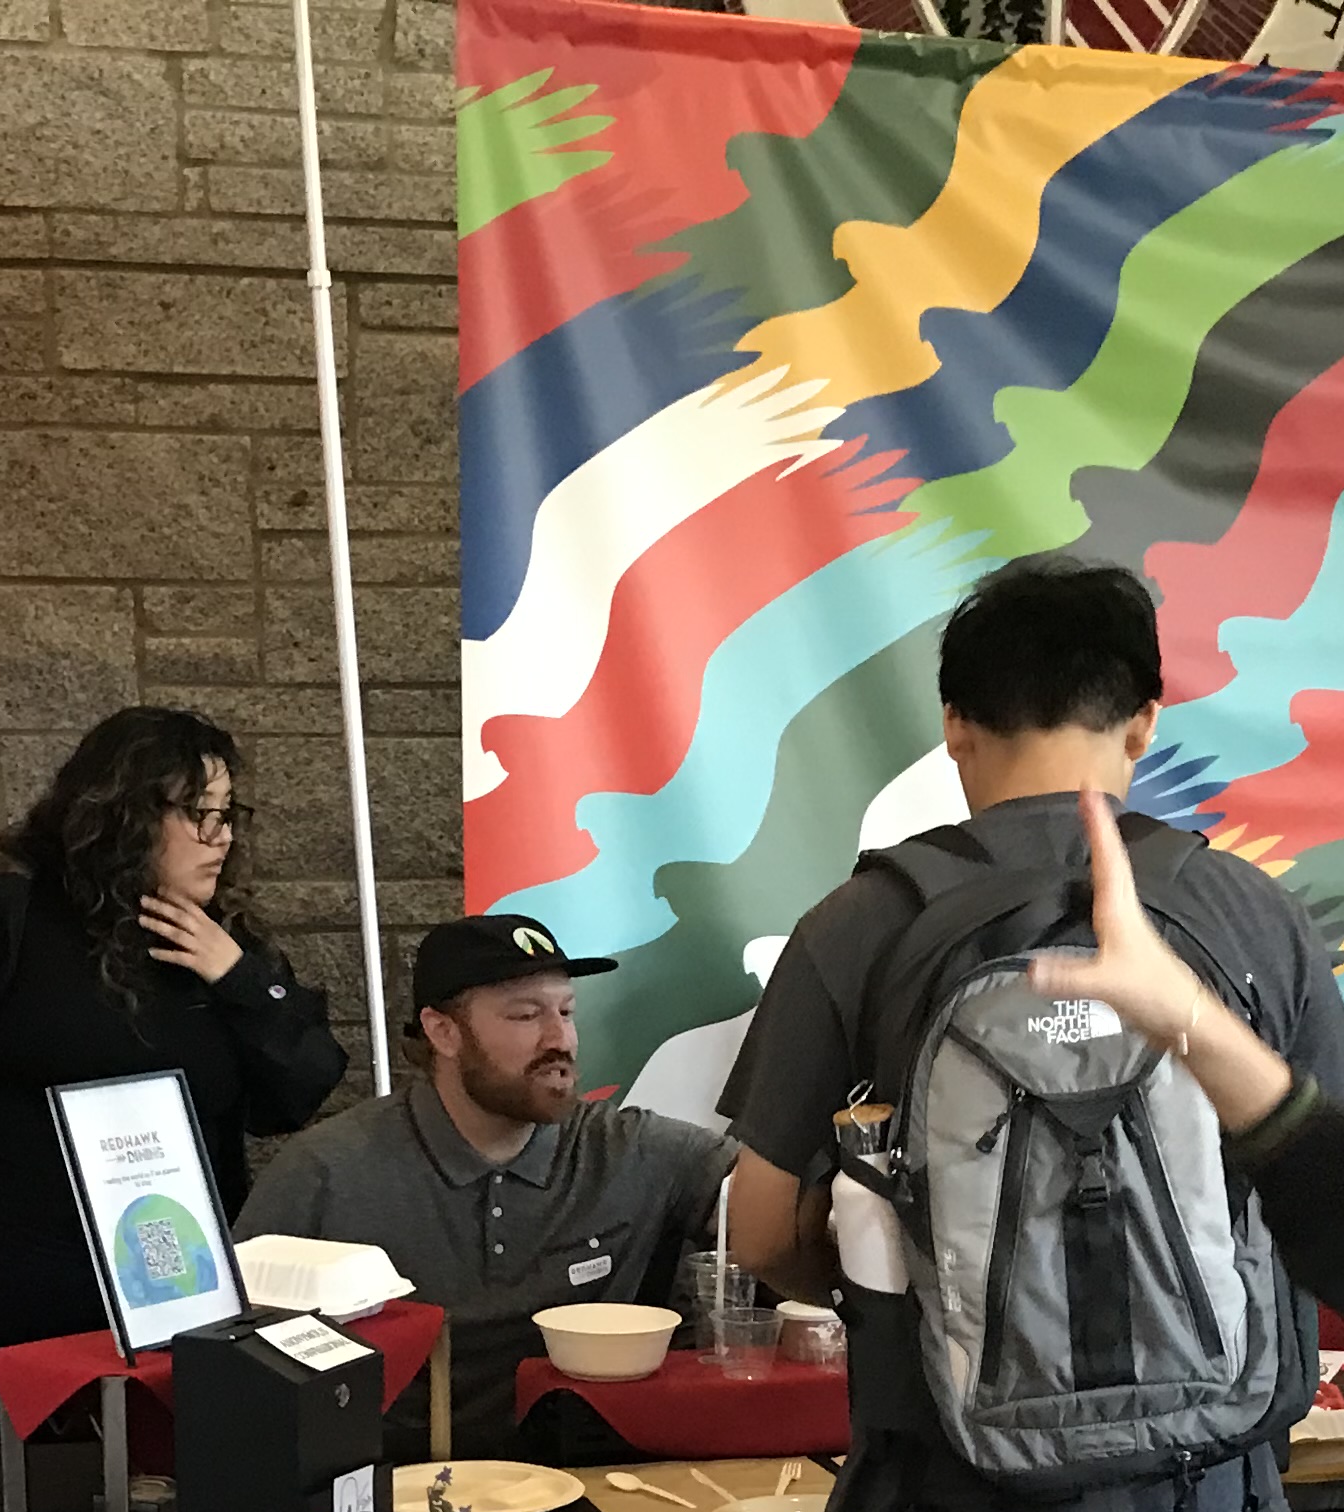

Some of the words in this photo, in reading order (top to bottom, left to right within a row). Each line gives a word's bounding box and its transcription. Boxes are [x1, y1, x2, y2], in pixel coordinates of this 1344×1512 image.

[1053, 999, 1089, 1016] THE
[1027, 1014, 1089, 1032] NORTH
[1046, 1028, 1091, 1044] FACE
[99, 1131, 161, 1153] REDHAWK
